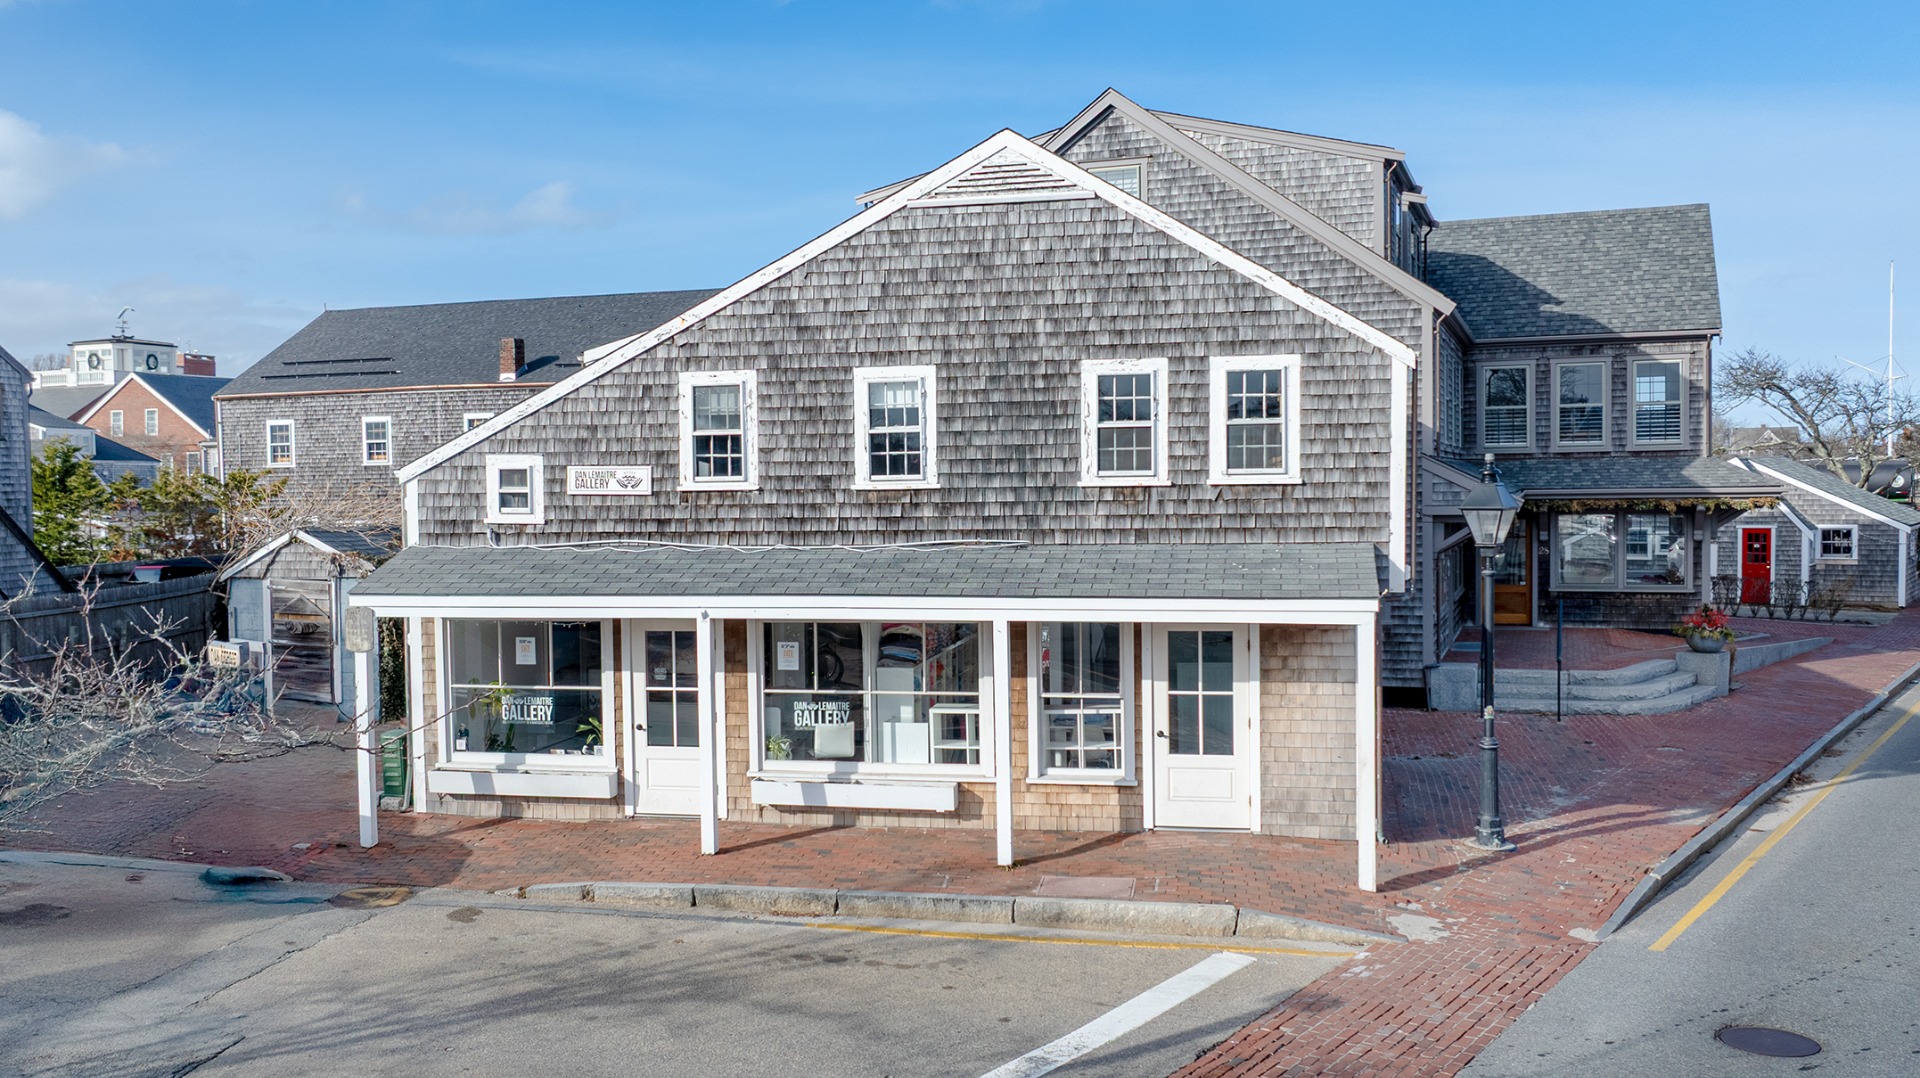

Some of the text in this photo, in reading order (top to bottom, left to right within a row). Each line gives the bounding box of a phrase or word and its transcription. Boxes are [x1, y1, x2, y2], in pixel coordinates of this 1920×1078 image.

[588, 471, 617, 479] LEMAITRE
[575, 479, 610, 489] GALLERY
[502, 696, 553, 705] DAN LEMAITRE
[794, 701, 850, 710] DAN LEMAITRE
[502, 704, 553, 721] GALLERY
[794, 710, 850, 726] GALLERY
